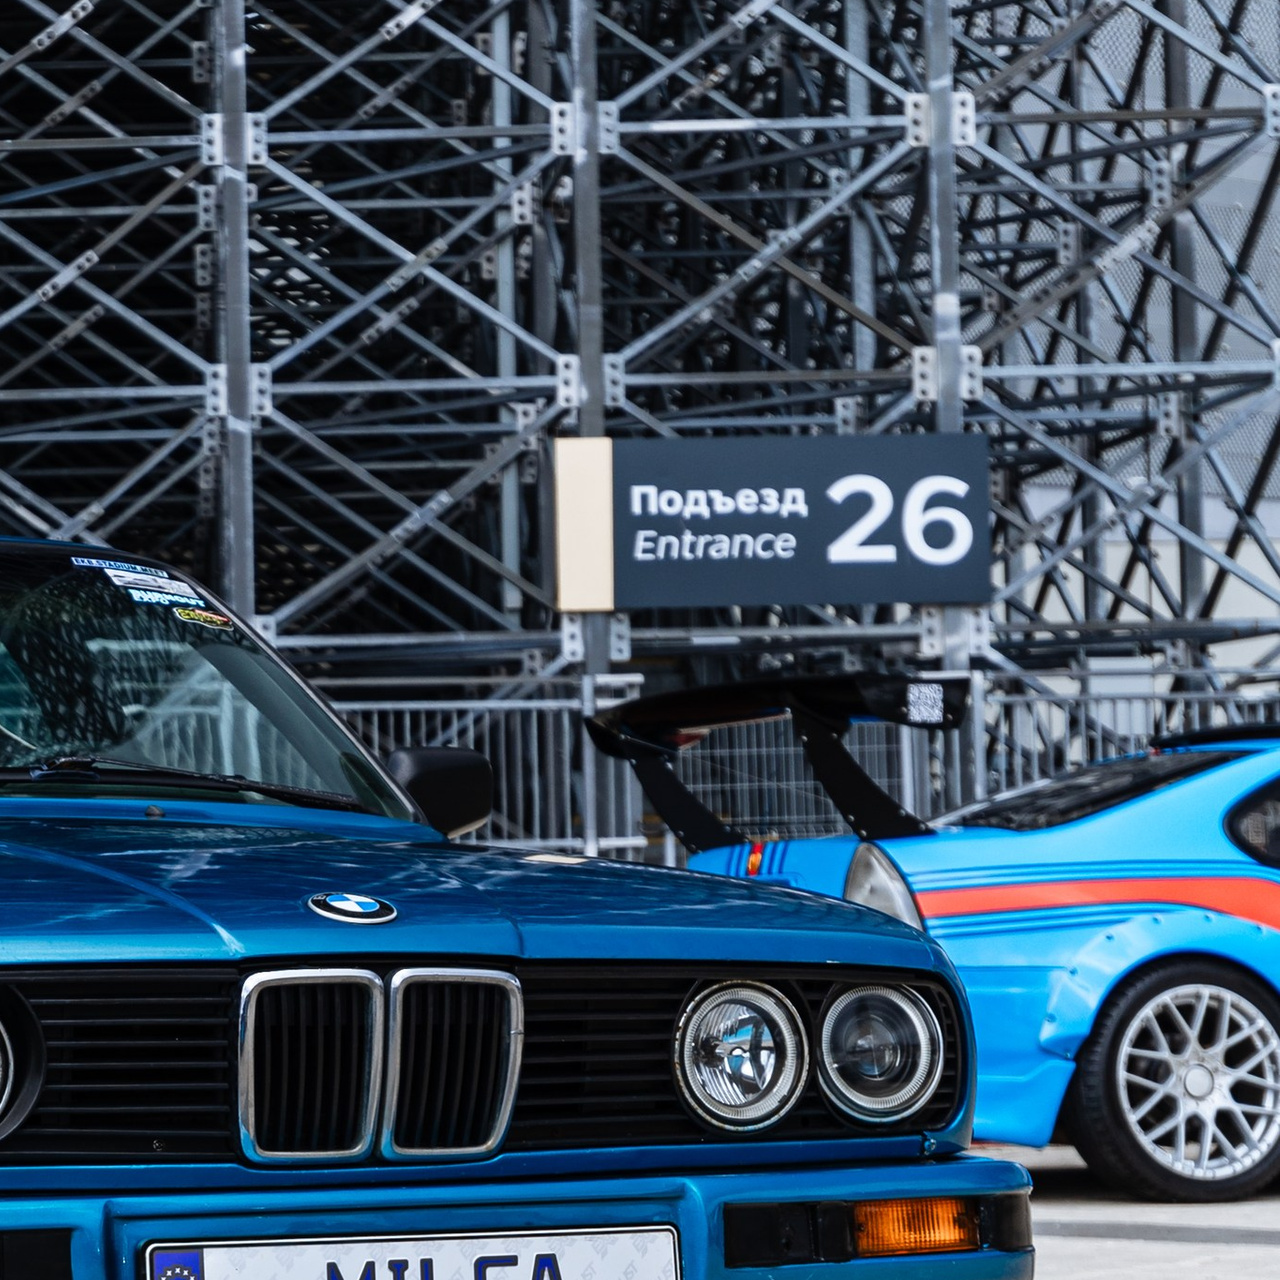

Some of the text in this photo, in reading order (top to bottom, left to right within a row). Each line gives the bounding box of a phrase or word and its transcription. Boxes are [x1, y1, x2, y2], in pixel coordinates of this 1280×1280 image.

[631, 485, 809, 519] Подъезд
[826, 474, 974, 566] 26
[634, 529, 797, 561] Entrance
